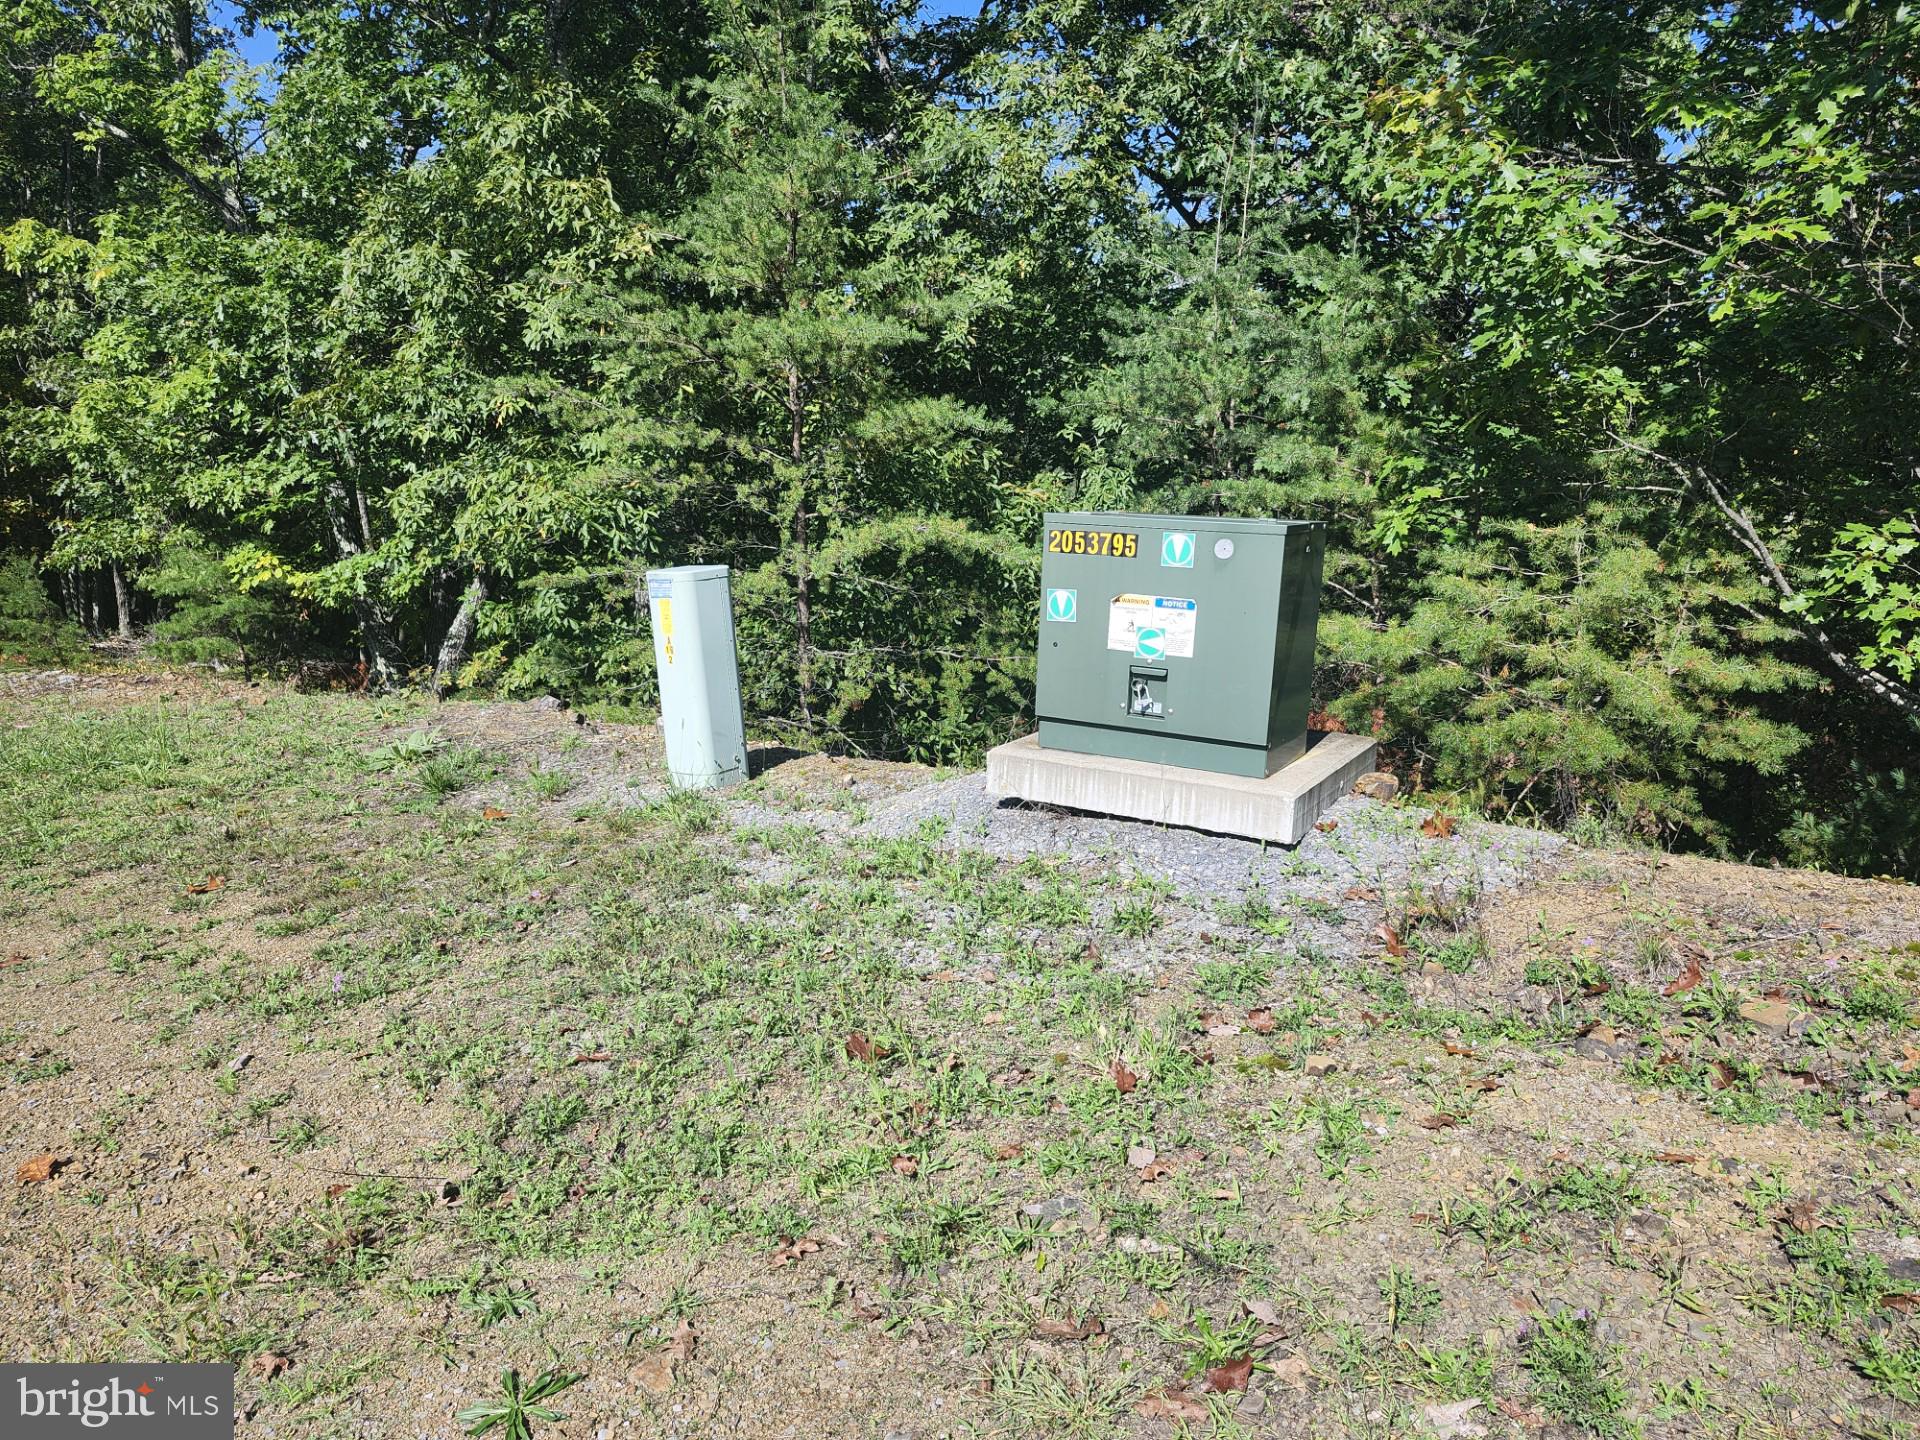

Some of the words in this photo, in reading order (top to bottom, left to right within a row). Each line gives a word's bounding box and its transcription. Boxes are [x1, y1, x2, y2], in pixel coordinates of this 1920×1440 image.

[1049, 530, 1137, 558] 2053795
[1121, 597, 1150, 606] WARNING
[1162, 600, 1188, 609] NOTICE
